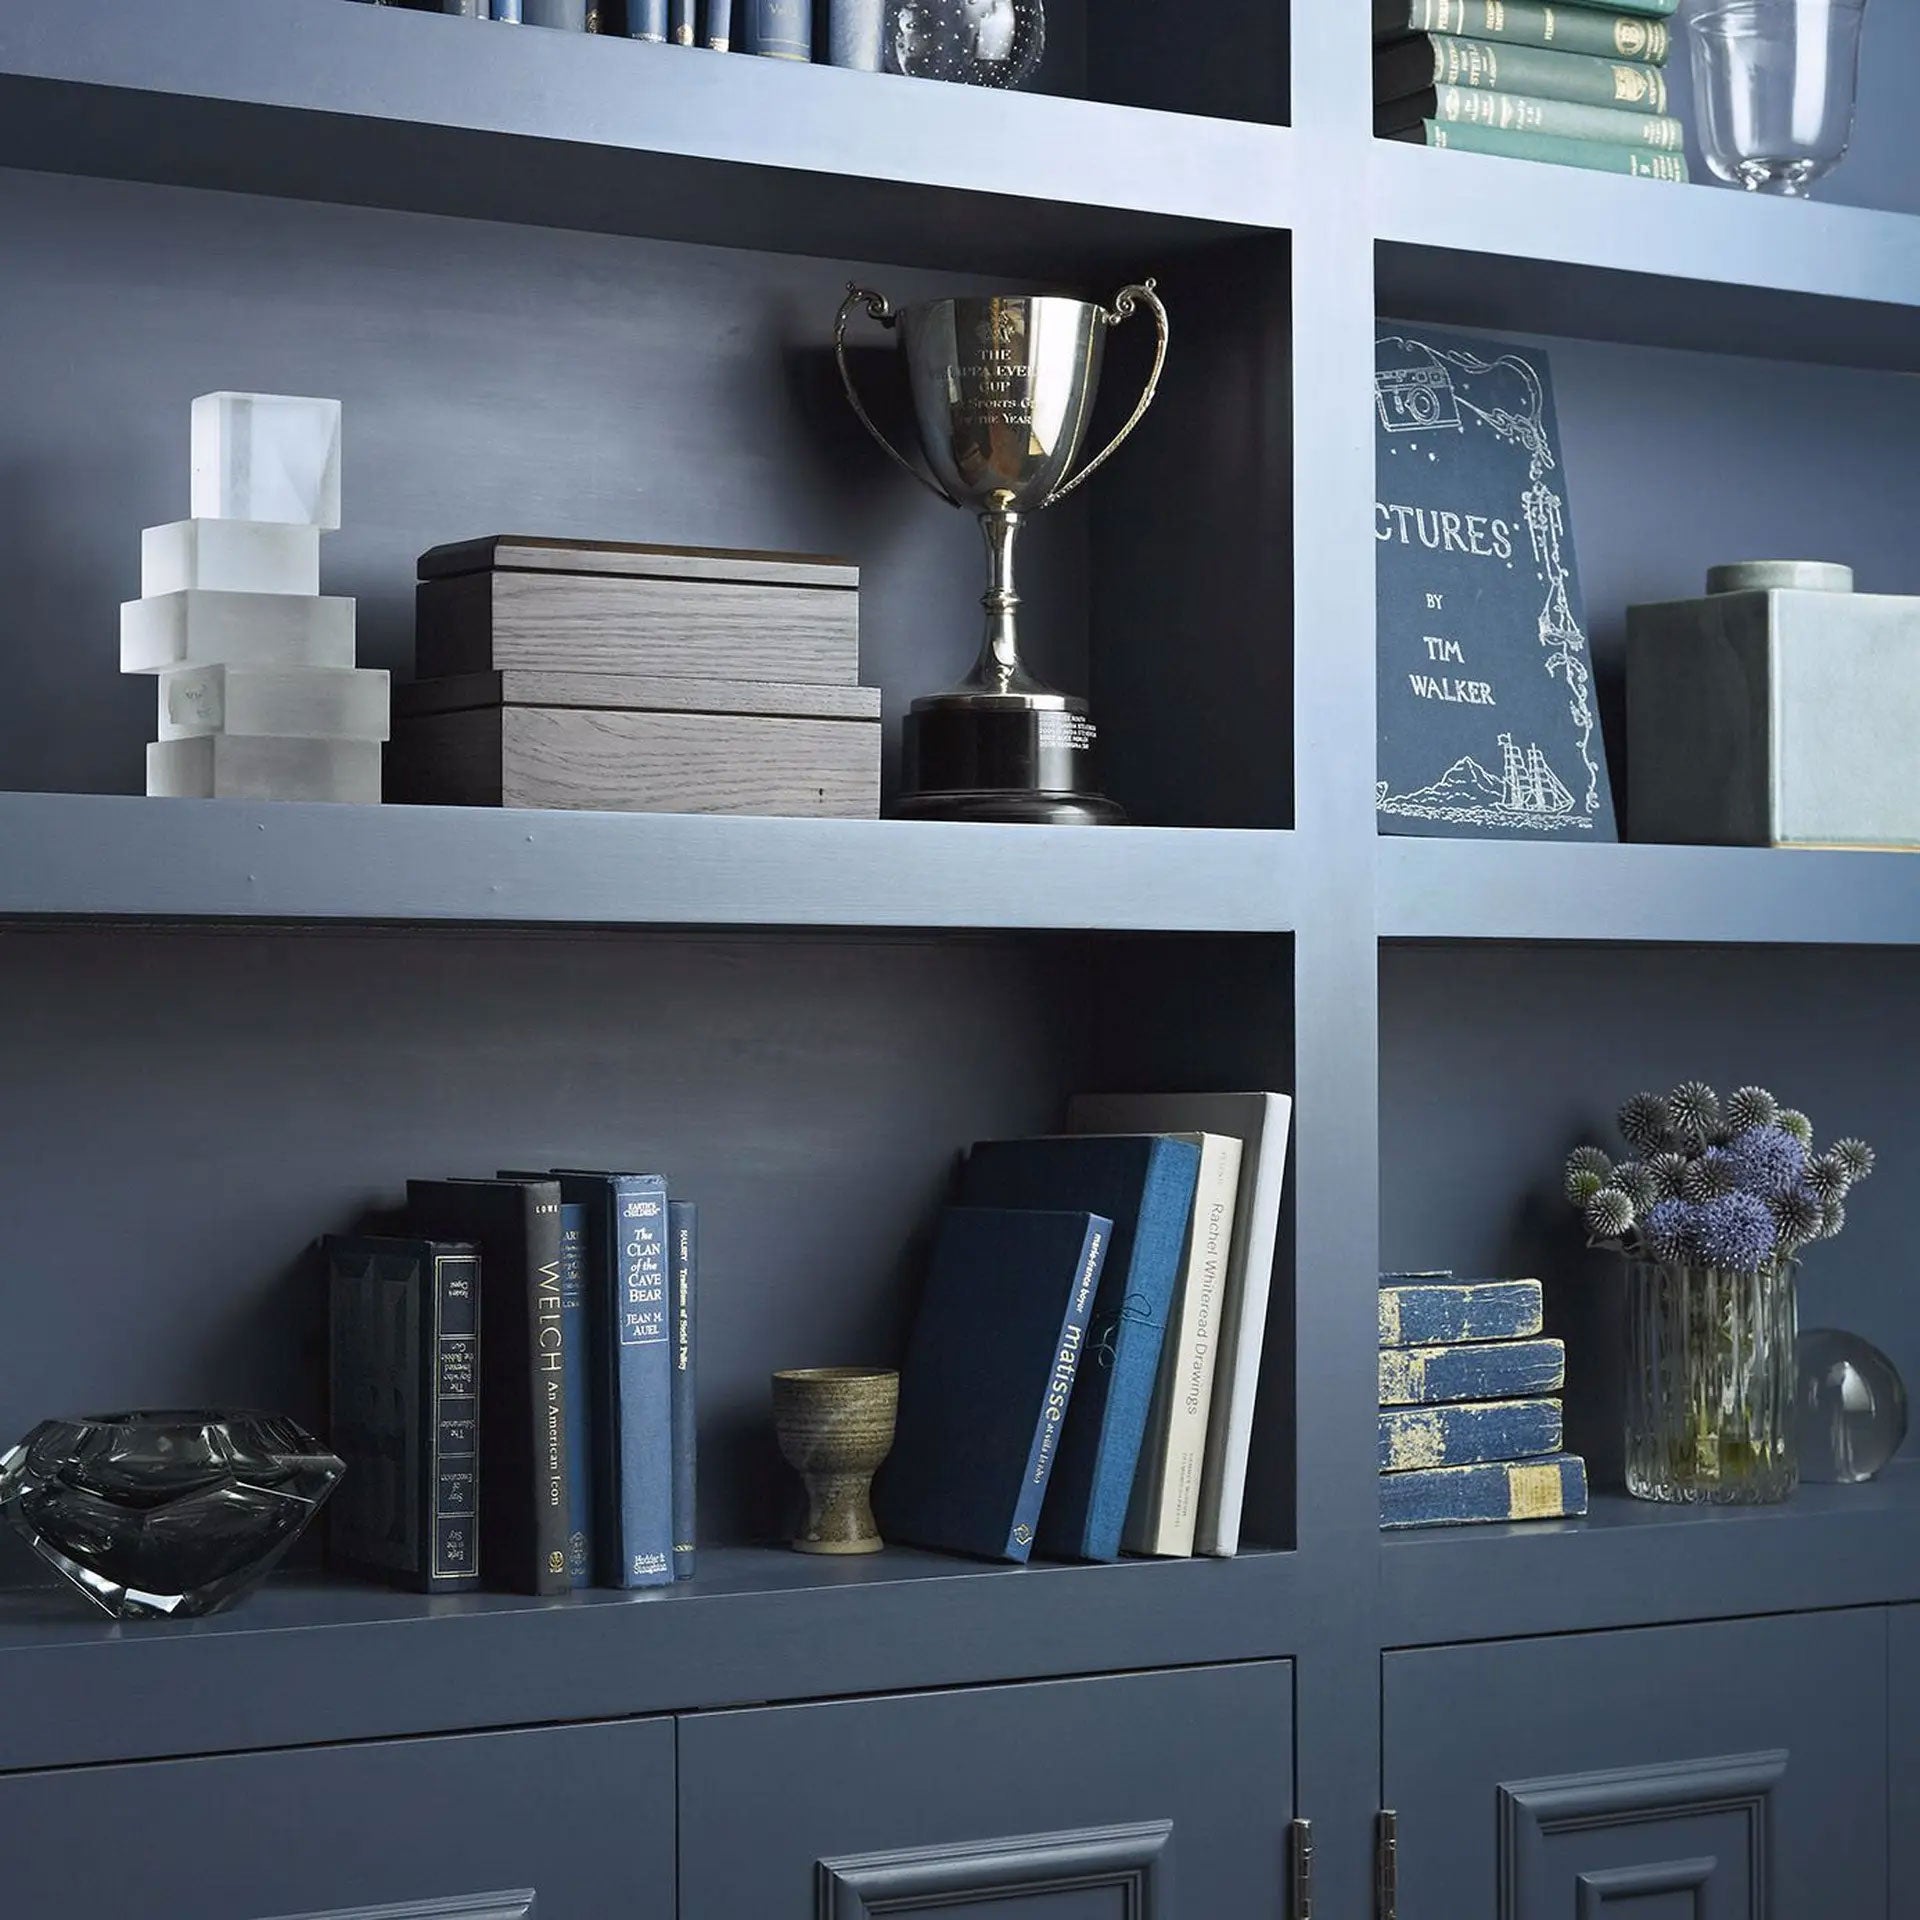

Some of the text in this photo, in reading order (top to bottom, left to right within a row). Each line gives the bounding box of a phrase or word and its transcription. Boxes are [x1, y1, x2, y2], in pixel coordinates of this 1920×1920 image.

[979, 349, 1011, 361] THE
[979, 381, 1011, 393] CUP
[1426, 593, 1443, 609] BY
[1423, 636, 1465, 664] TIM
[1409, 674, 1496, 705] WALKER
[634, 1227, 652, 1240] The
[627, 1243, 661, 1257] CLAN
[631, 1257, 657, 1274] of the
[628, 1273, 661, 1287] CAVE
[629, 1289, 662, 1303] BEAR
[1185, 1202, 1224, 1416] Rachel Whiteread Drawings
[626, 1312, 651, 1327] JEAN
[633, 1325, 659, 1337] AUEL
[1045, 1324, 1081, 1421] matisse
[538, 1260, 562, 1506] WELCH An American Icon
